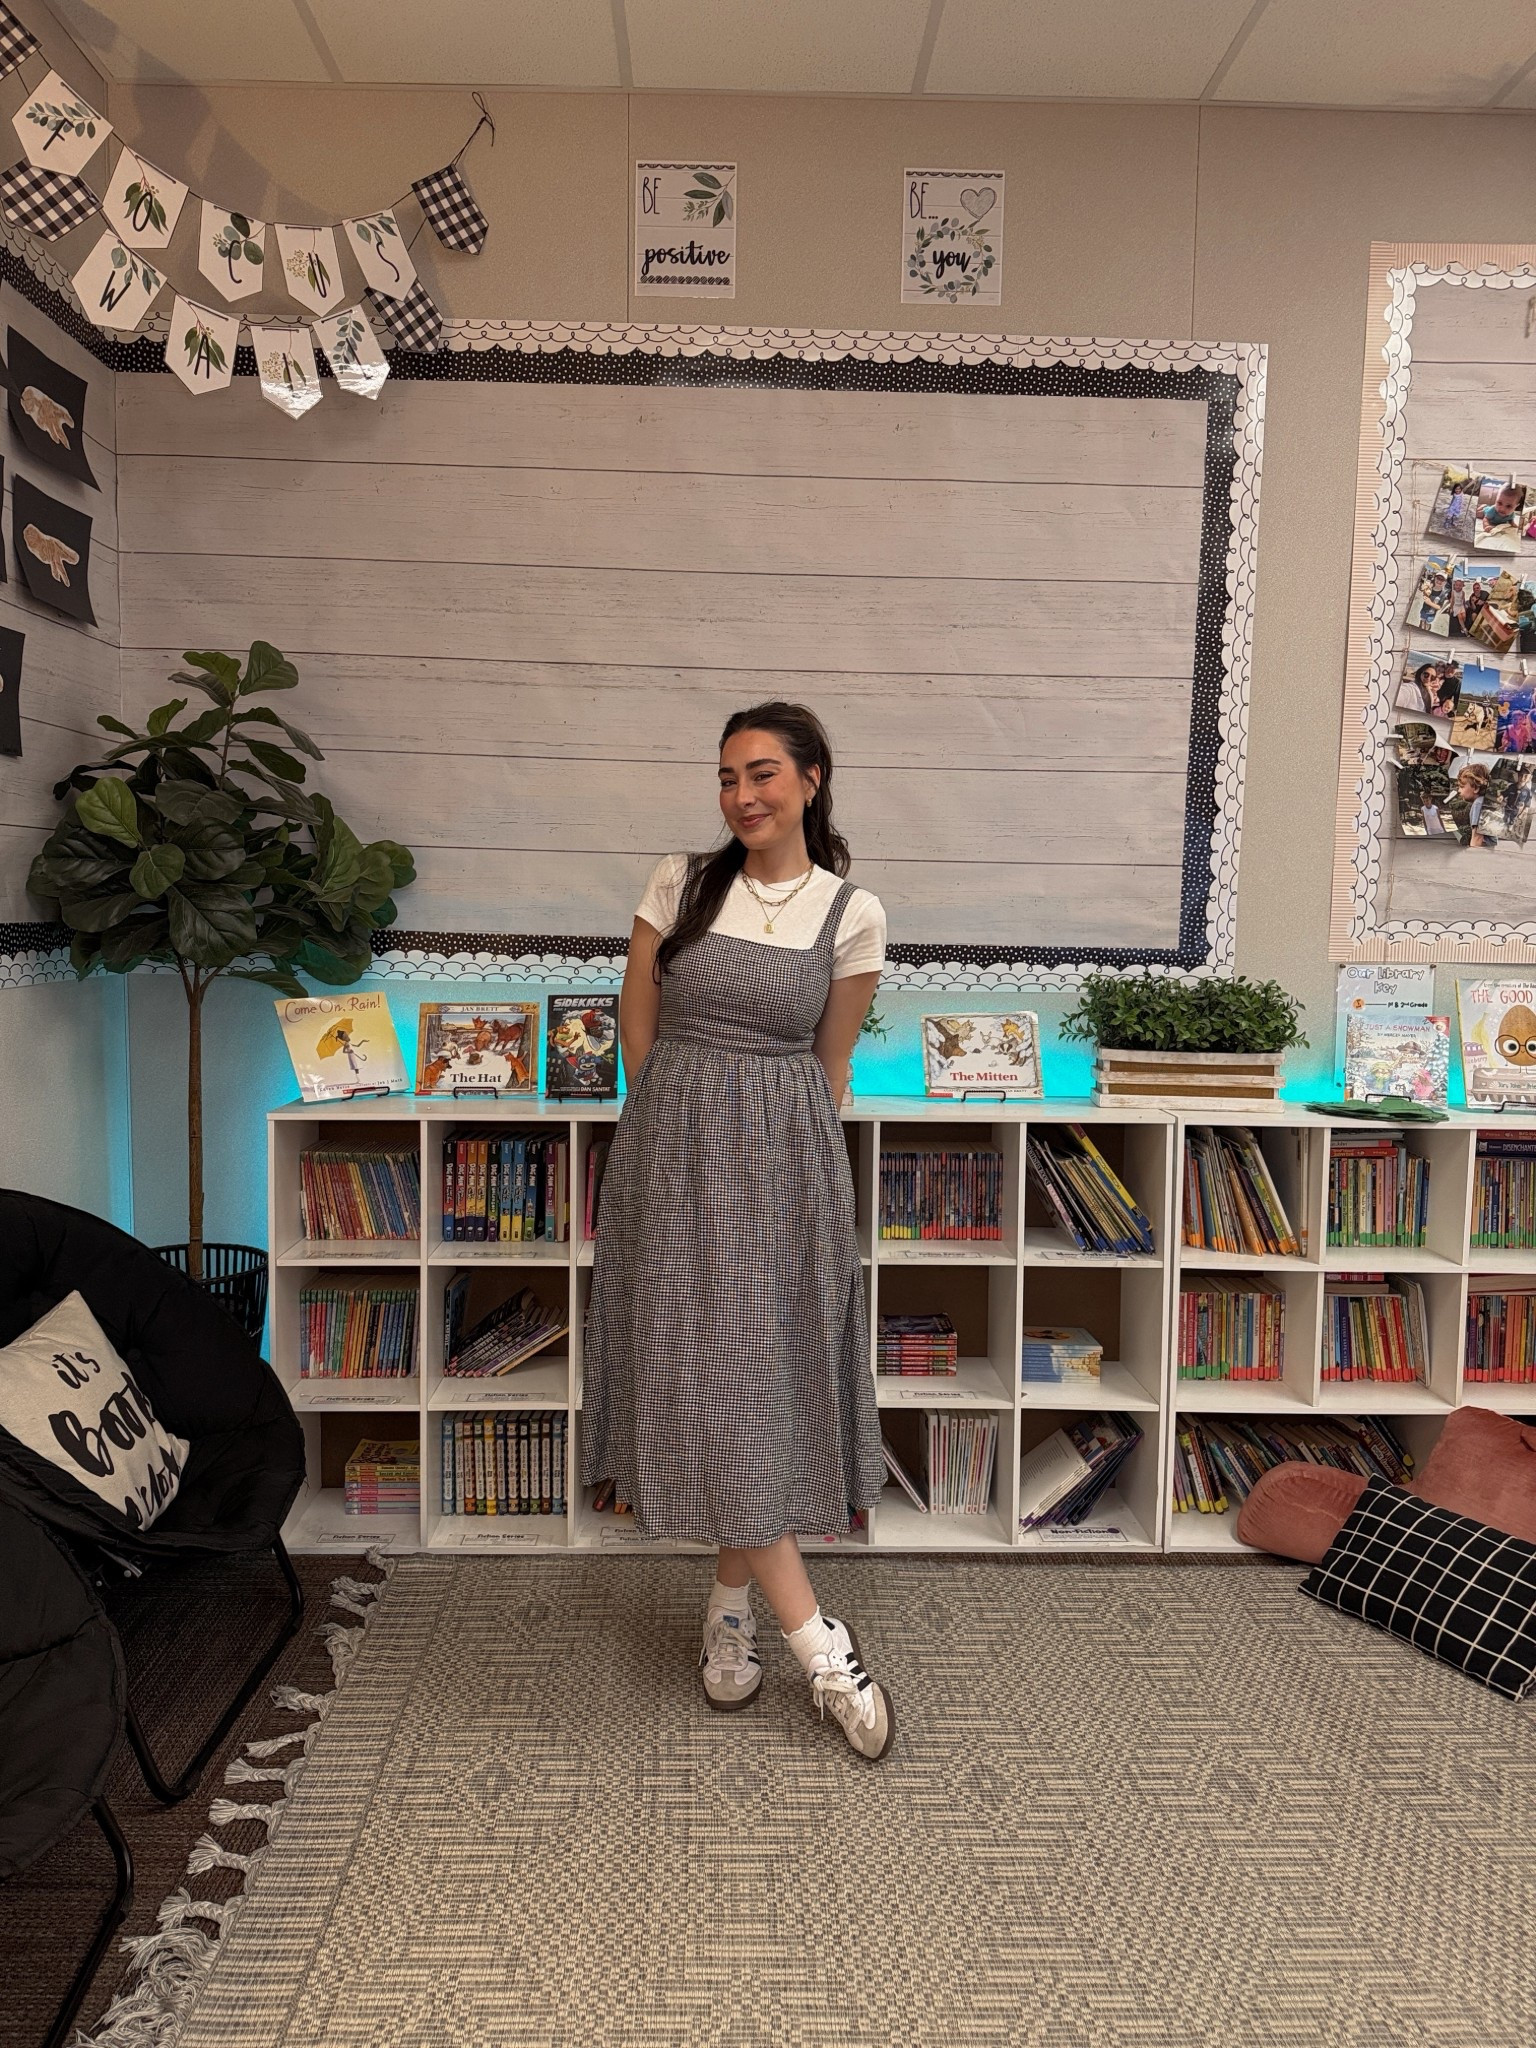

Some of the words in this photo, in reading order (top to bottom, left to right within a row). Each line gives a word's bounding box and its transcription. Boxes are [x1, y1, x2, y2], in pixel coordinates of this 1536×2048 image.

[643, 176, 661, 214] BE
[641, 240, 730, 276] positive
[932, 250, 971, 279] you
[1346, 966, 1374, 979] Our
[1377, 966, 1424, 981] Library
[1373, 980, 1398, 995] Key
[1470, 989, 1494, 1004] THE
[1500, 989, 1534, 1005] GOOD
[284, 1001, 317, 1023] Come
[318, 999, 346, 1013] On,
[346, 994, 381, 1012] Rain!
[1392, 1024, 1431, 1032] SNOWMAN
[450, 1073, 475, 1083] The
[477, 1073, 502, 1083] Hat
[950, 1072, 975, 1081] The
[976, 1072, 1018, 1081] Mitten
[52, 1351, 100, 1389] it's
